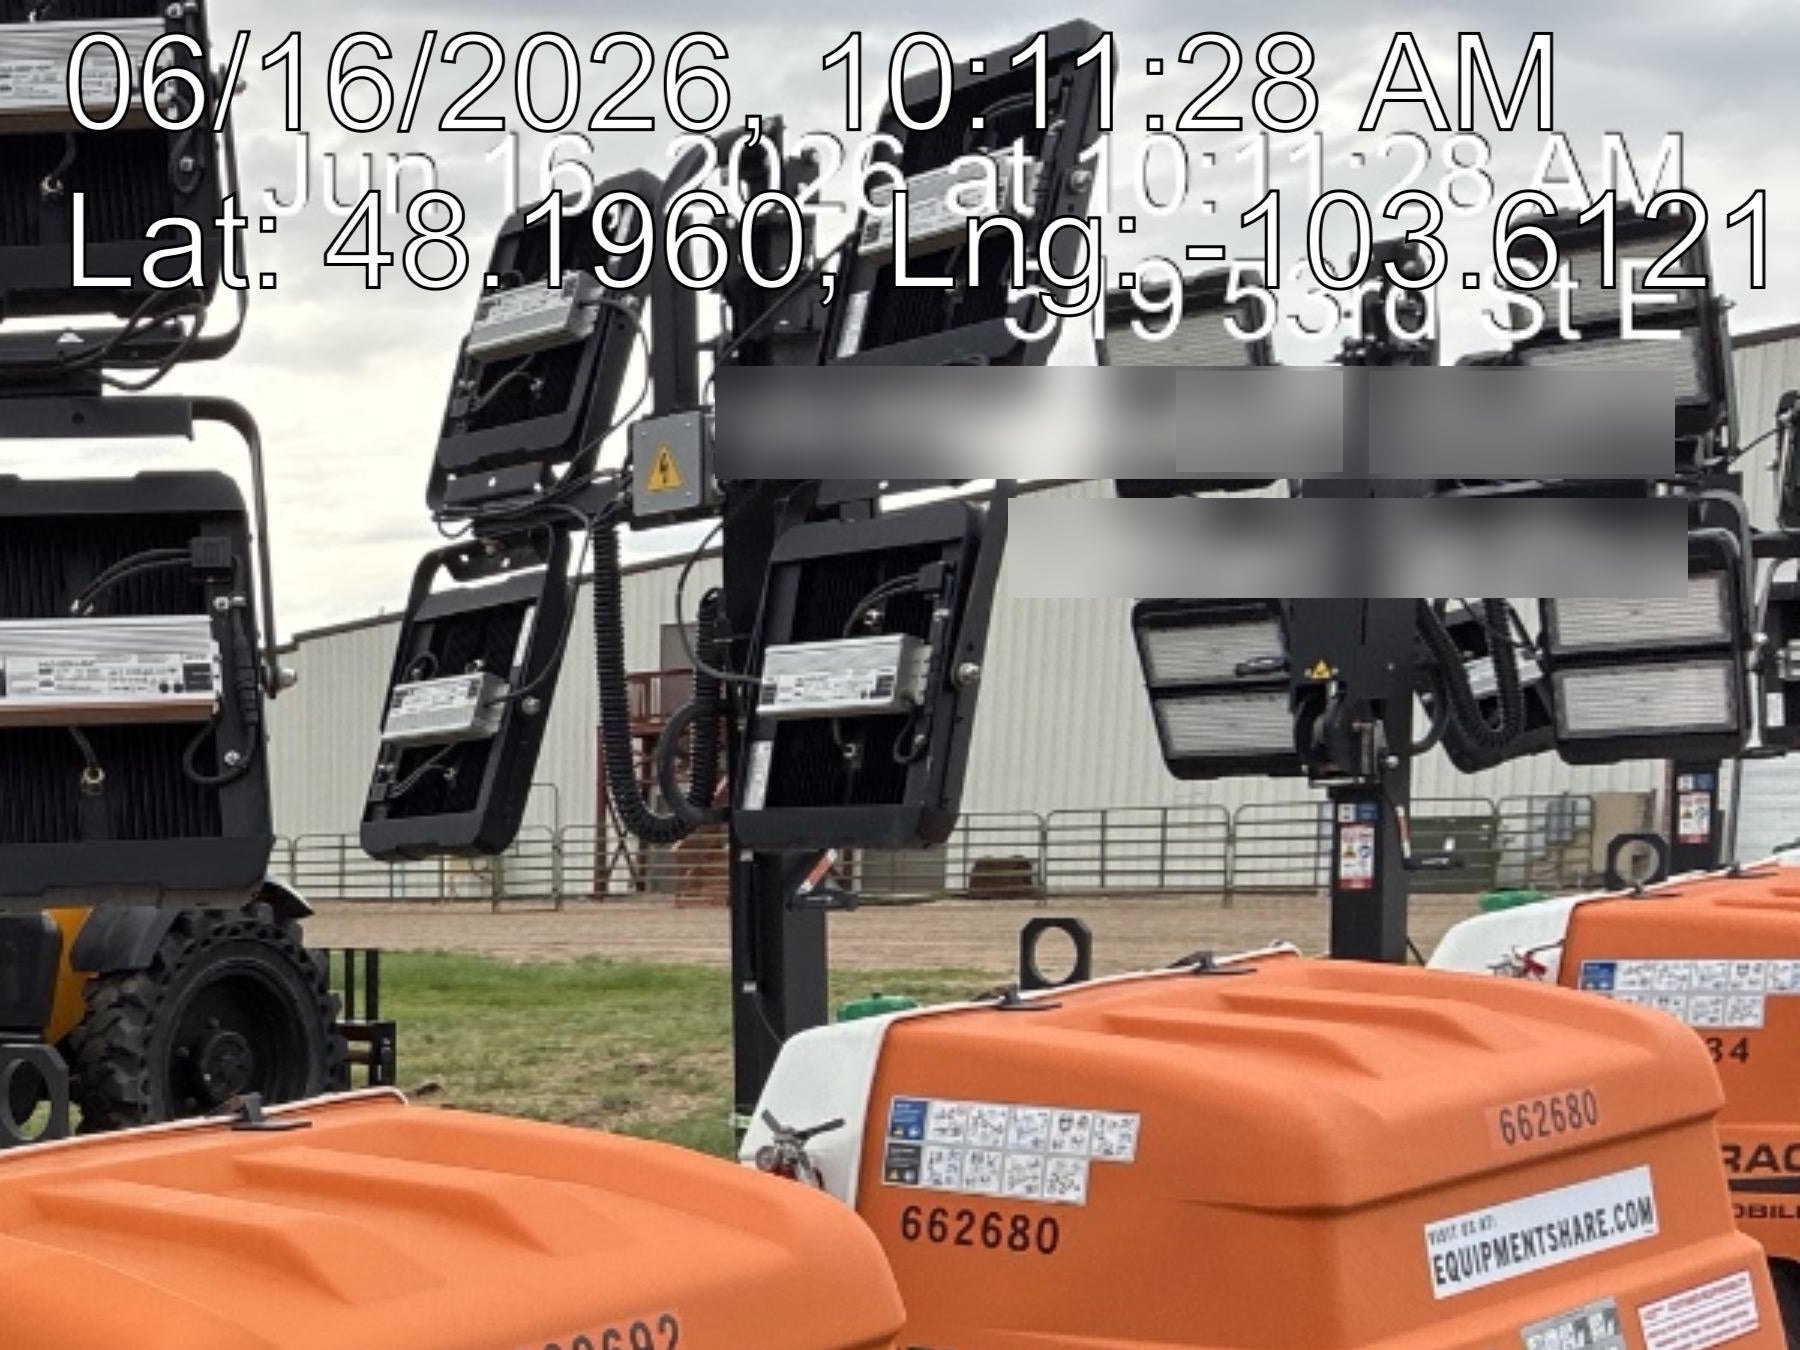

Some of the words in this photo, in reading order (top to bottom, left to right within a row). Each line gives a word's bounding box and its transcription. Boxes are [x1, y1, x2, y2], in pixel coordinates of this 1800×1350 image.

[1706, 1036, 1751, 1063] 34
[1500, 1089, 1598, 1146] 662680
[901, 1205, 1060, 1255] 662680
[1433, 1196, 1654, 1285] EQUIPMENTSHARE.COM
